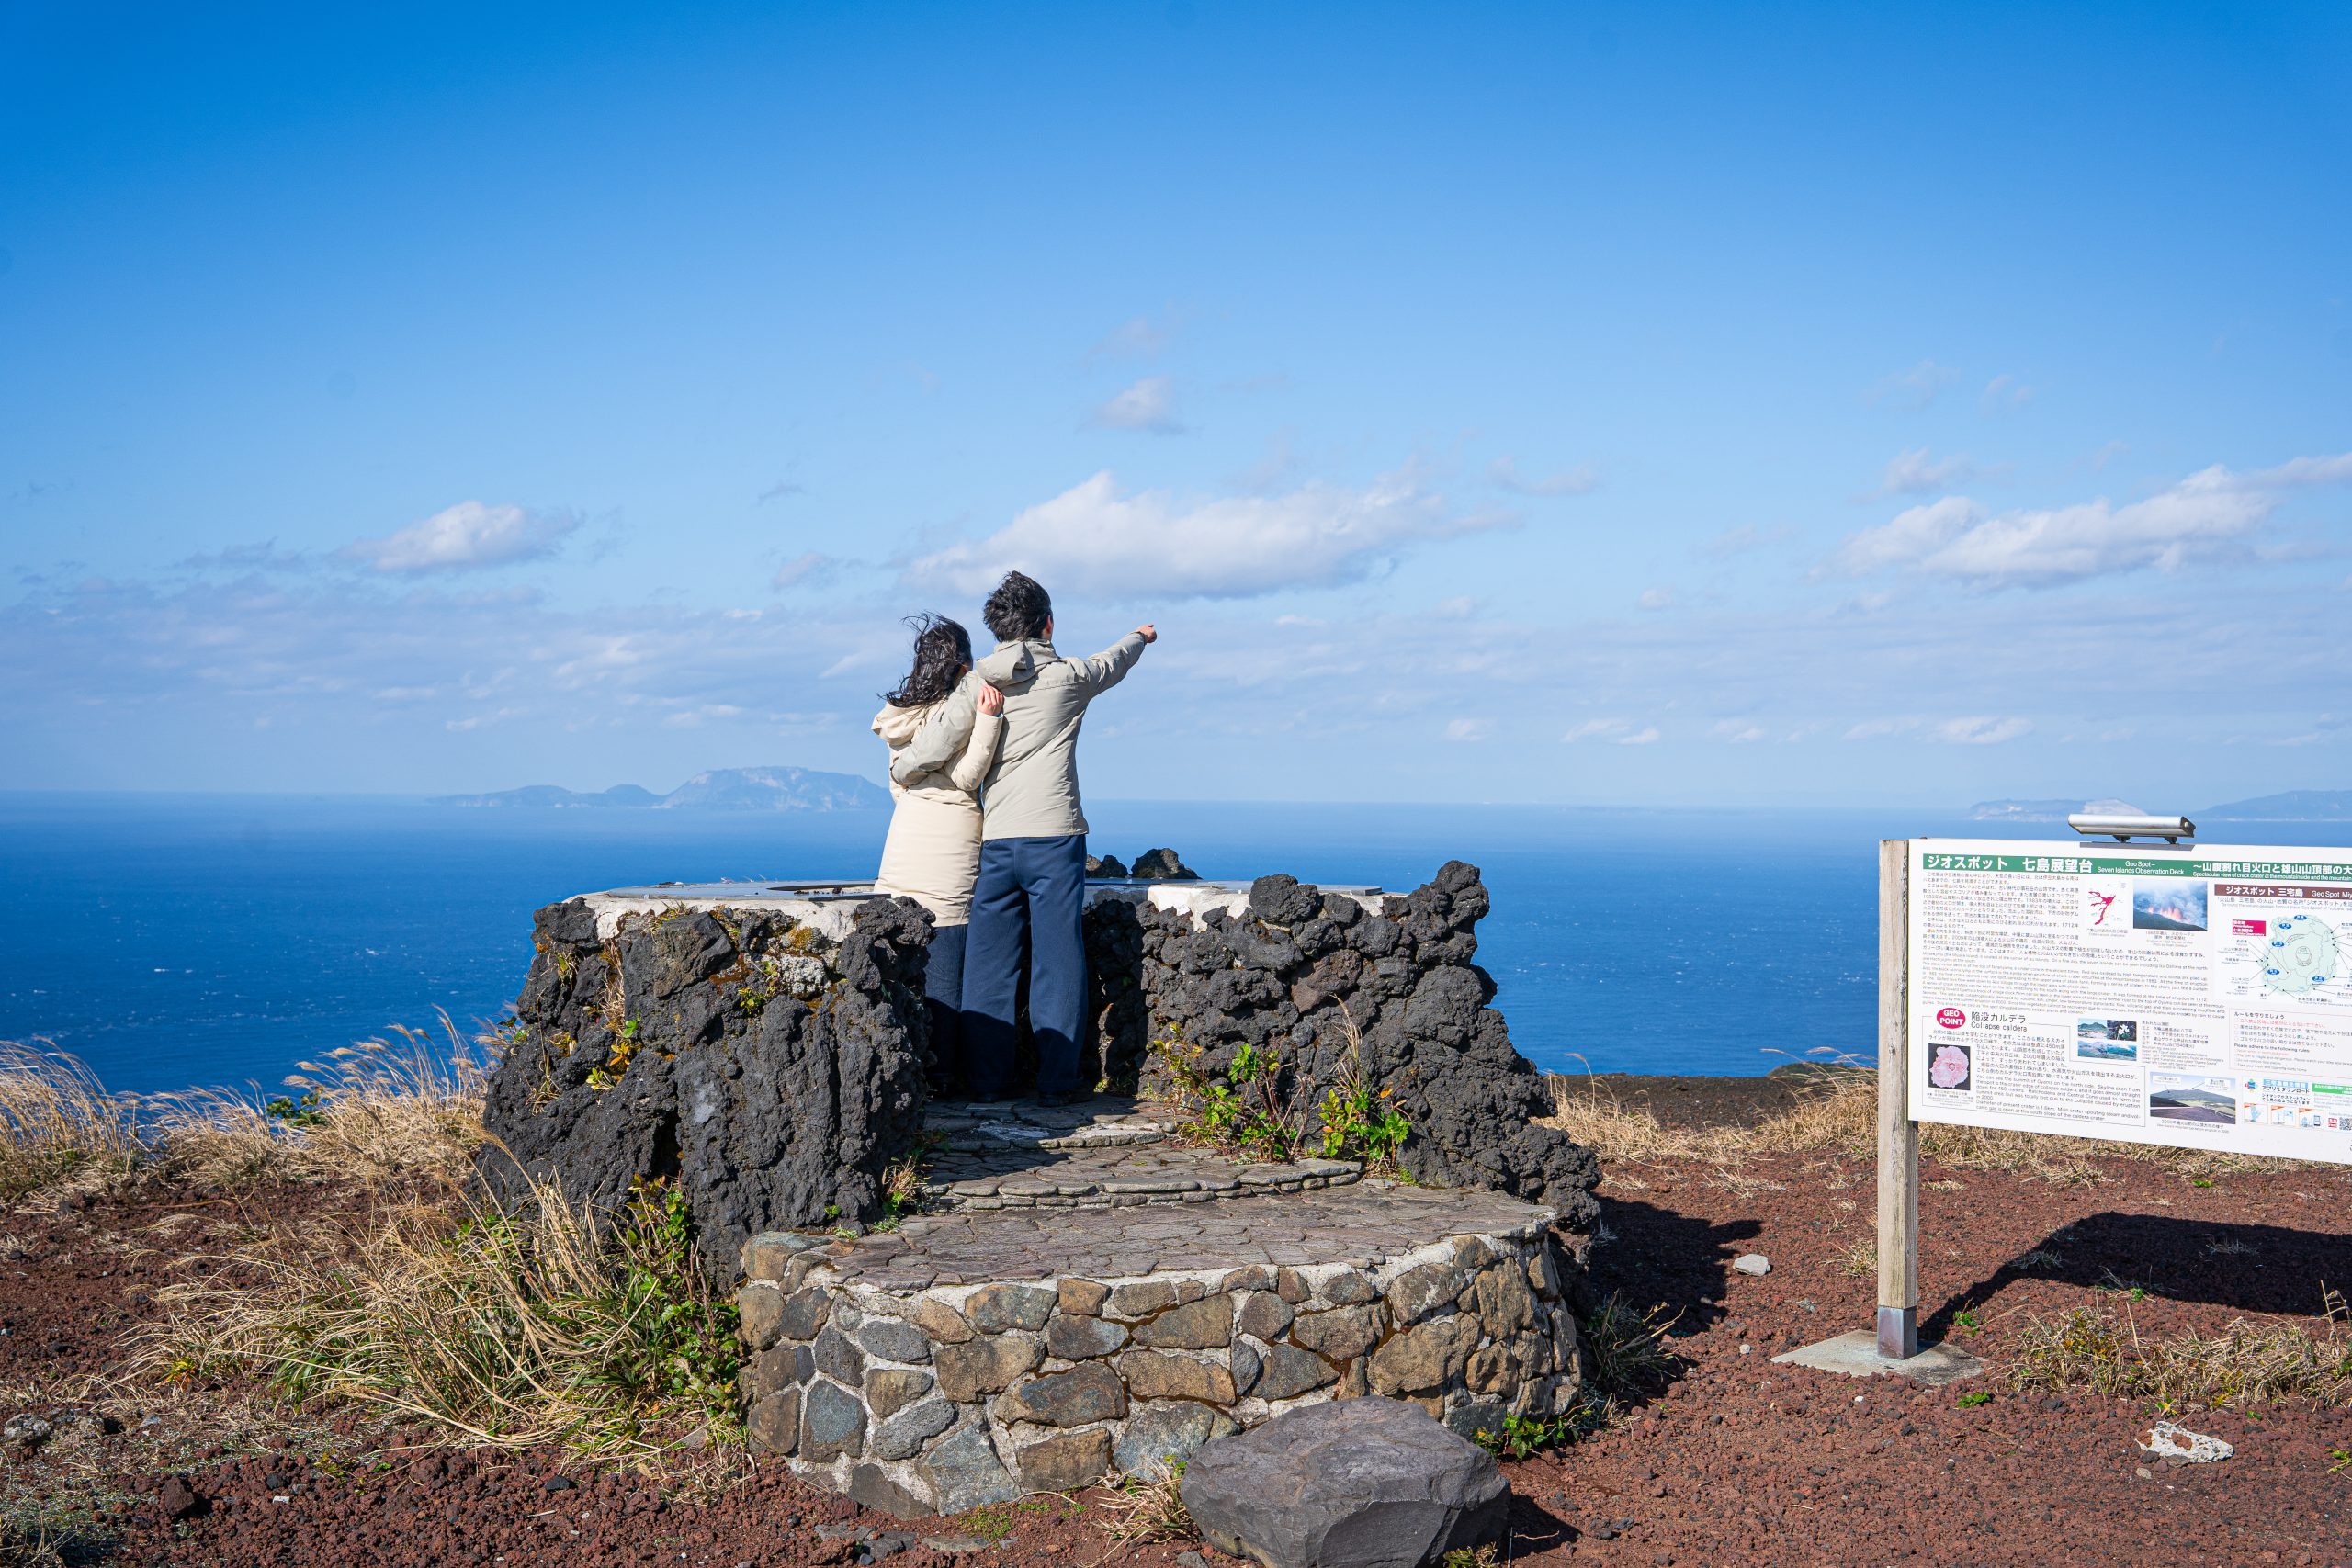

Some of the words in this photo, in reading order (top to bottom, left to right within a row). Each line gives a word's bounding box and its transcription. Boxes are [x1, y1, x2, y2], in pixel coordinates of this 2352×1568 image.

[1928, 855, 2007, 870] ジオスポット
[2022, 858, 2093, 873] 七島展望台
[2226, 886, 2274, 895] ジオスポット
[2278, 887, 2303, 897] 三宅島
[2325, 890, 2340, 898] Spot
[1972, 1012, 2026, 1023] 陥没カルデラ
[2234, 1011, 2284, 1020] ルールを守りましょう
